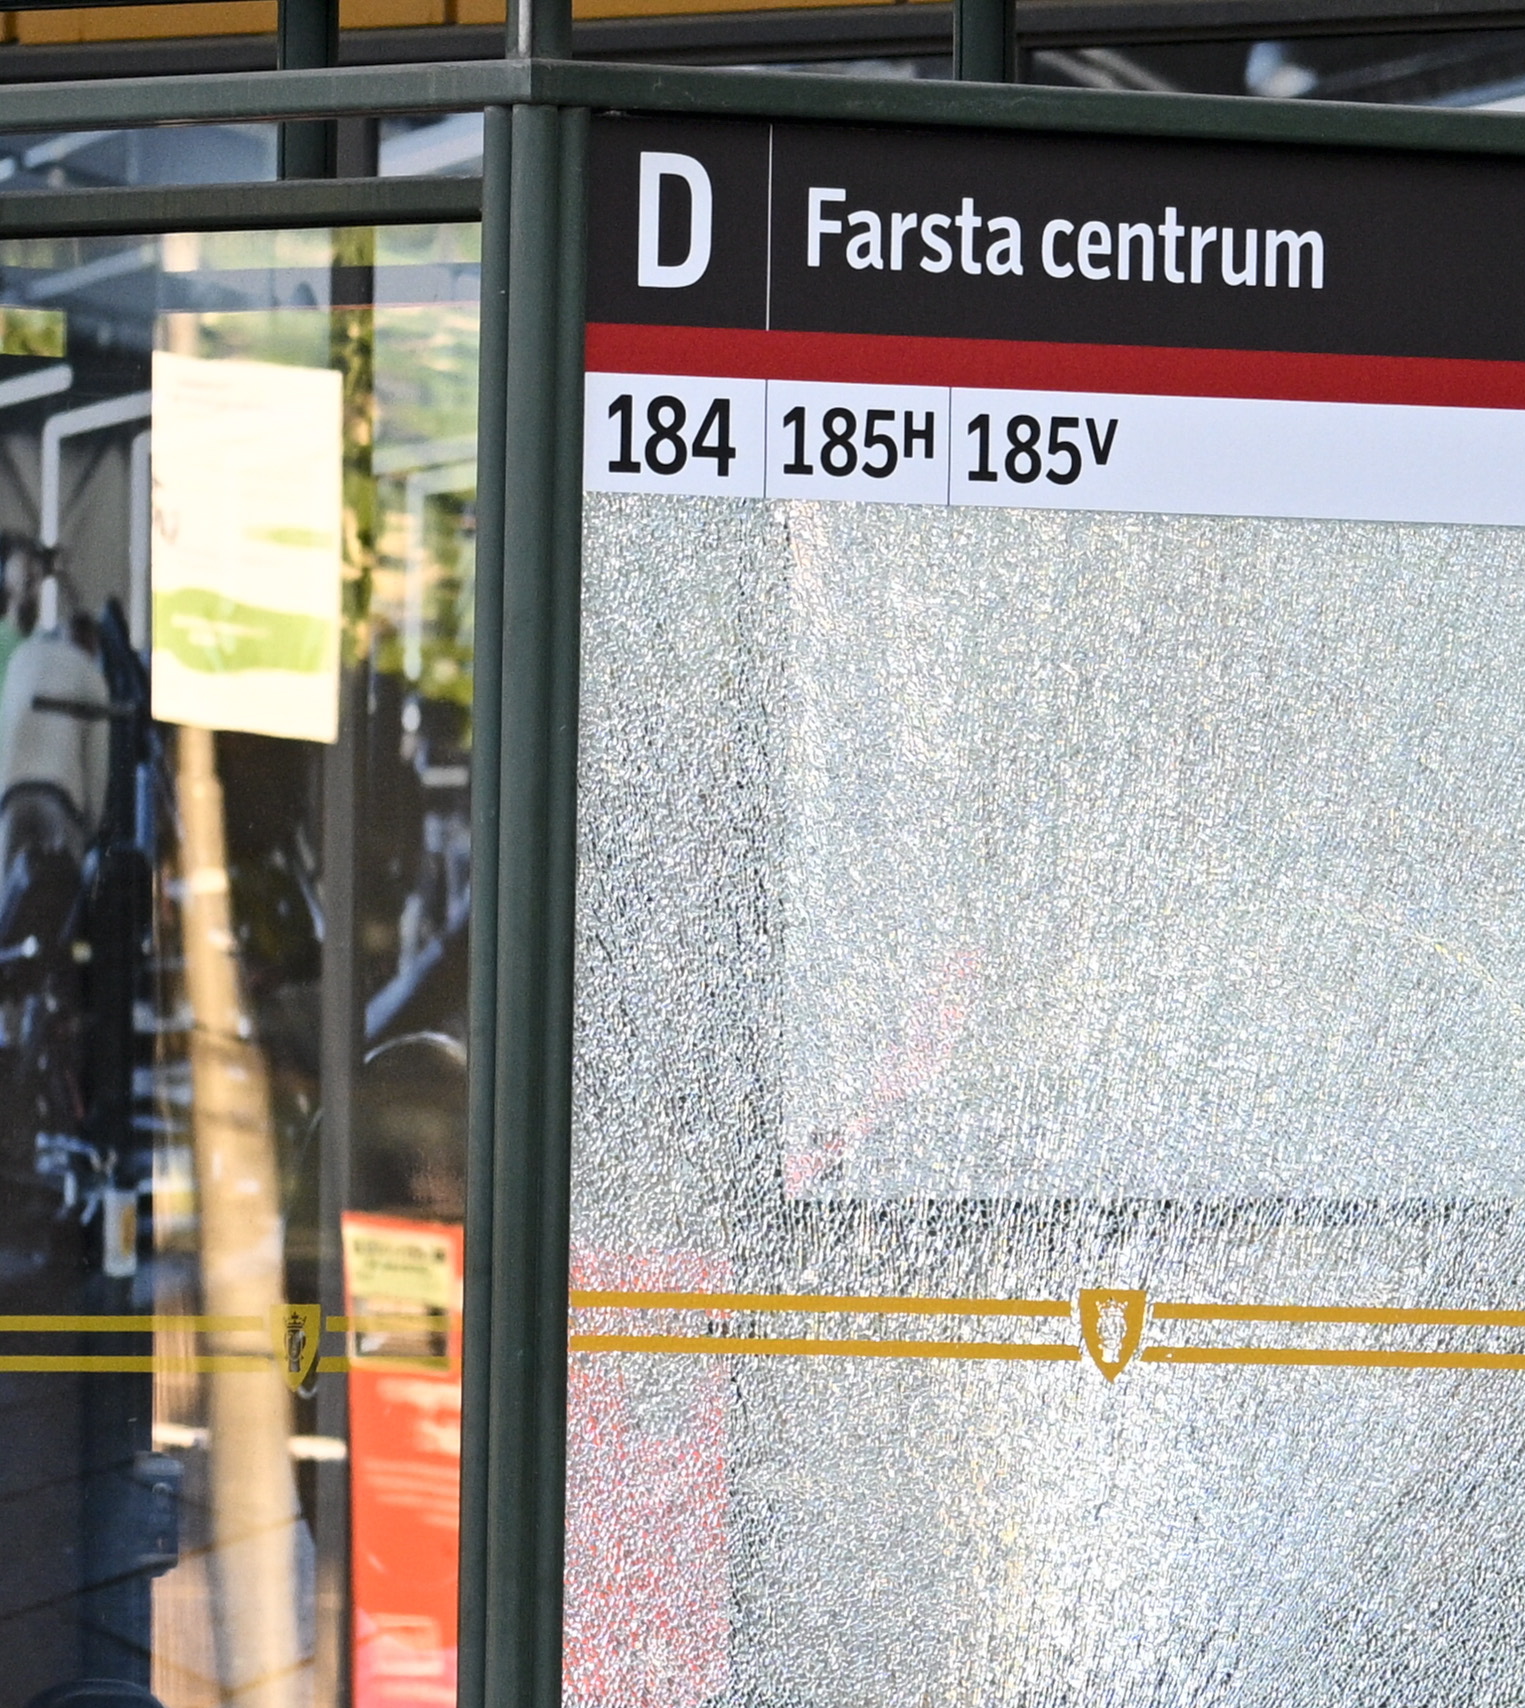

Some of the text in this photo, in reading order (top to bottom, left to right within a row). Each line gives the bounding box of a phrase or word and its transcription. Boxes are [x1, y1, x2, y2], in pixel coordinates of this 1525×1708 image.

[637, 150, 714, 288] D
[806, 186, 1324, 290] Farsta centrum
[608, 393, 737, 477] 184
[783, 405, 935, 479] 185H
[967, 413, 1120, 486] 185V
